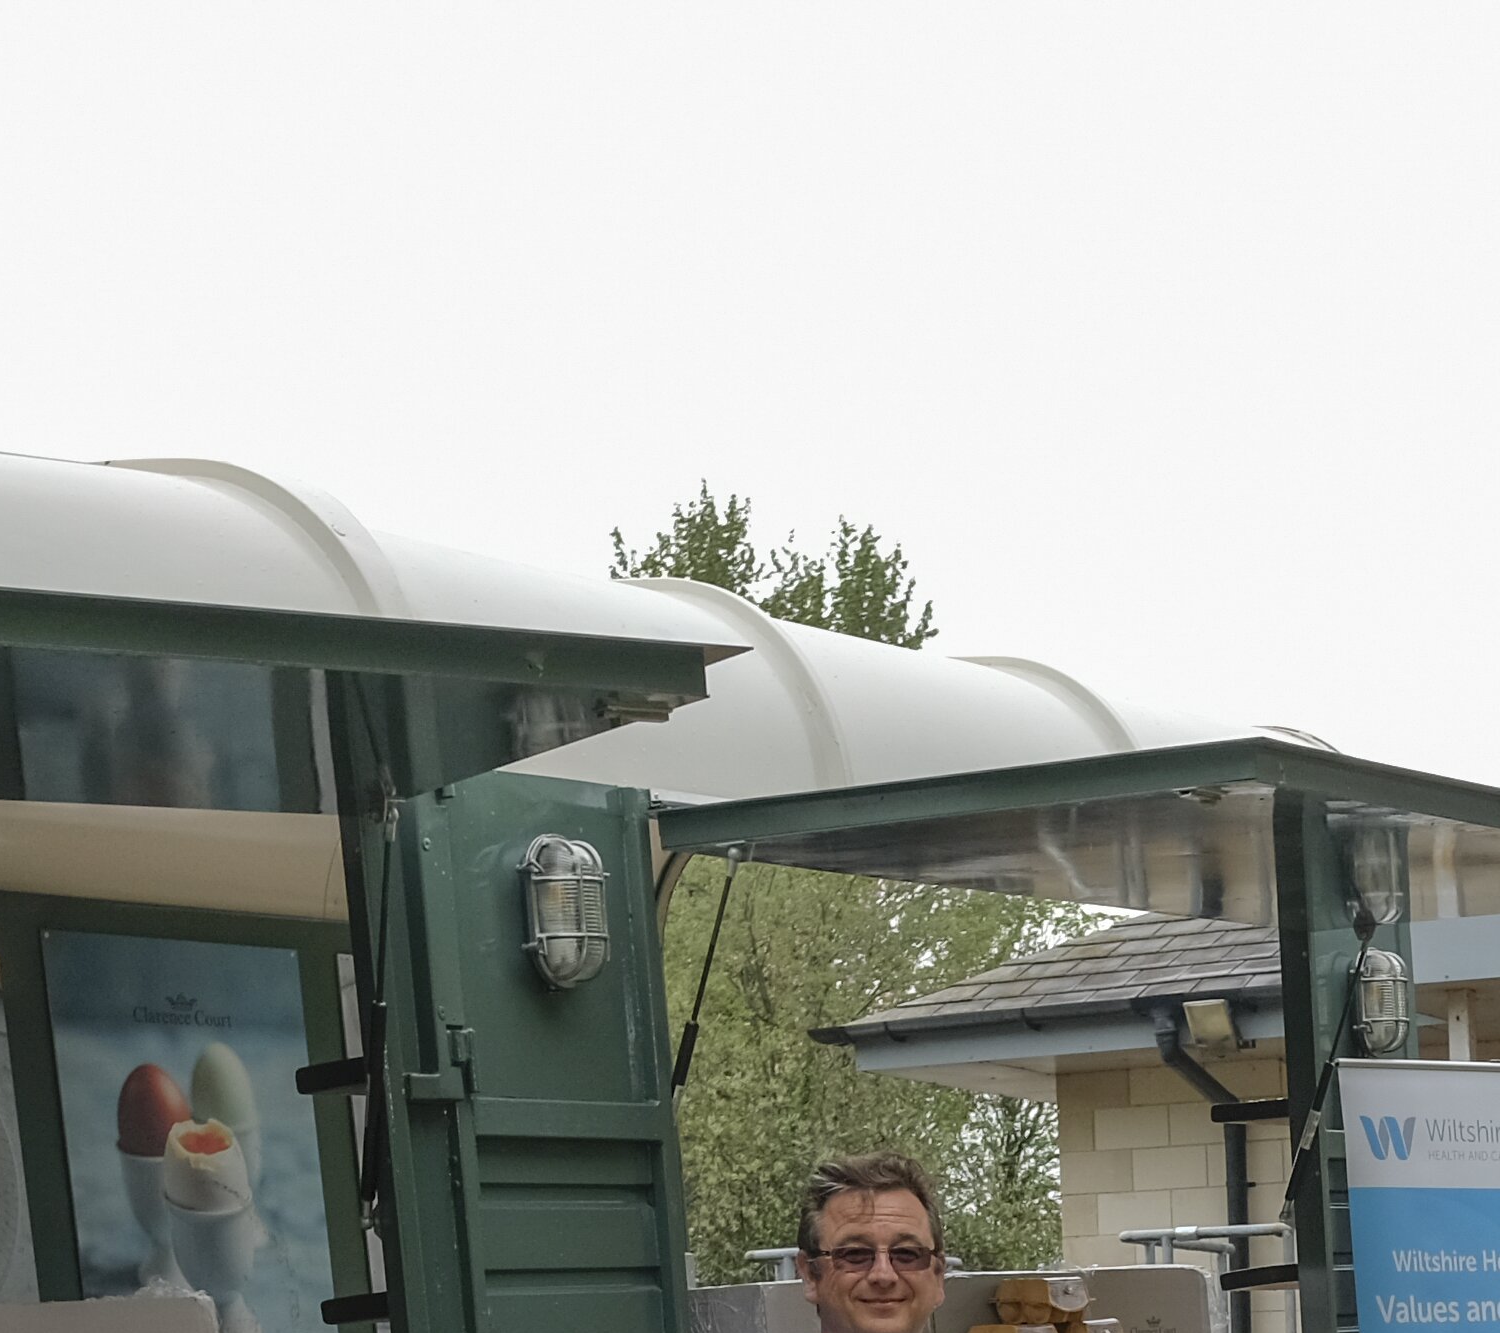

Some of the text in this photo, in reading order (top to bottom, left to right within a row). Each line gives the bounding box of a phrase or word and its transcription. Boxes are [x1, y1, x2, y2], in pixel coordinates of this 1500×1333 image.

[133, 1006, 232, 1028] Clarence Court
[1428, 1150, 1464, 1161] HEALTH
[1468, 1151, 1488, 1161] AND
[1393, 1249, 1477, 1272] Wiltshire
[1376, 1294, 1460, 1324] Values
